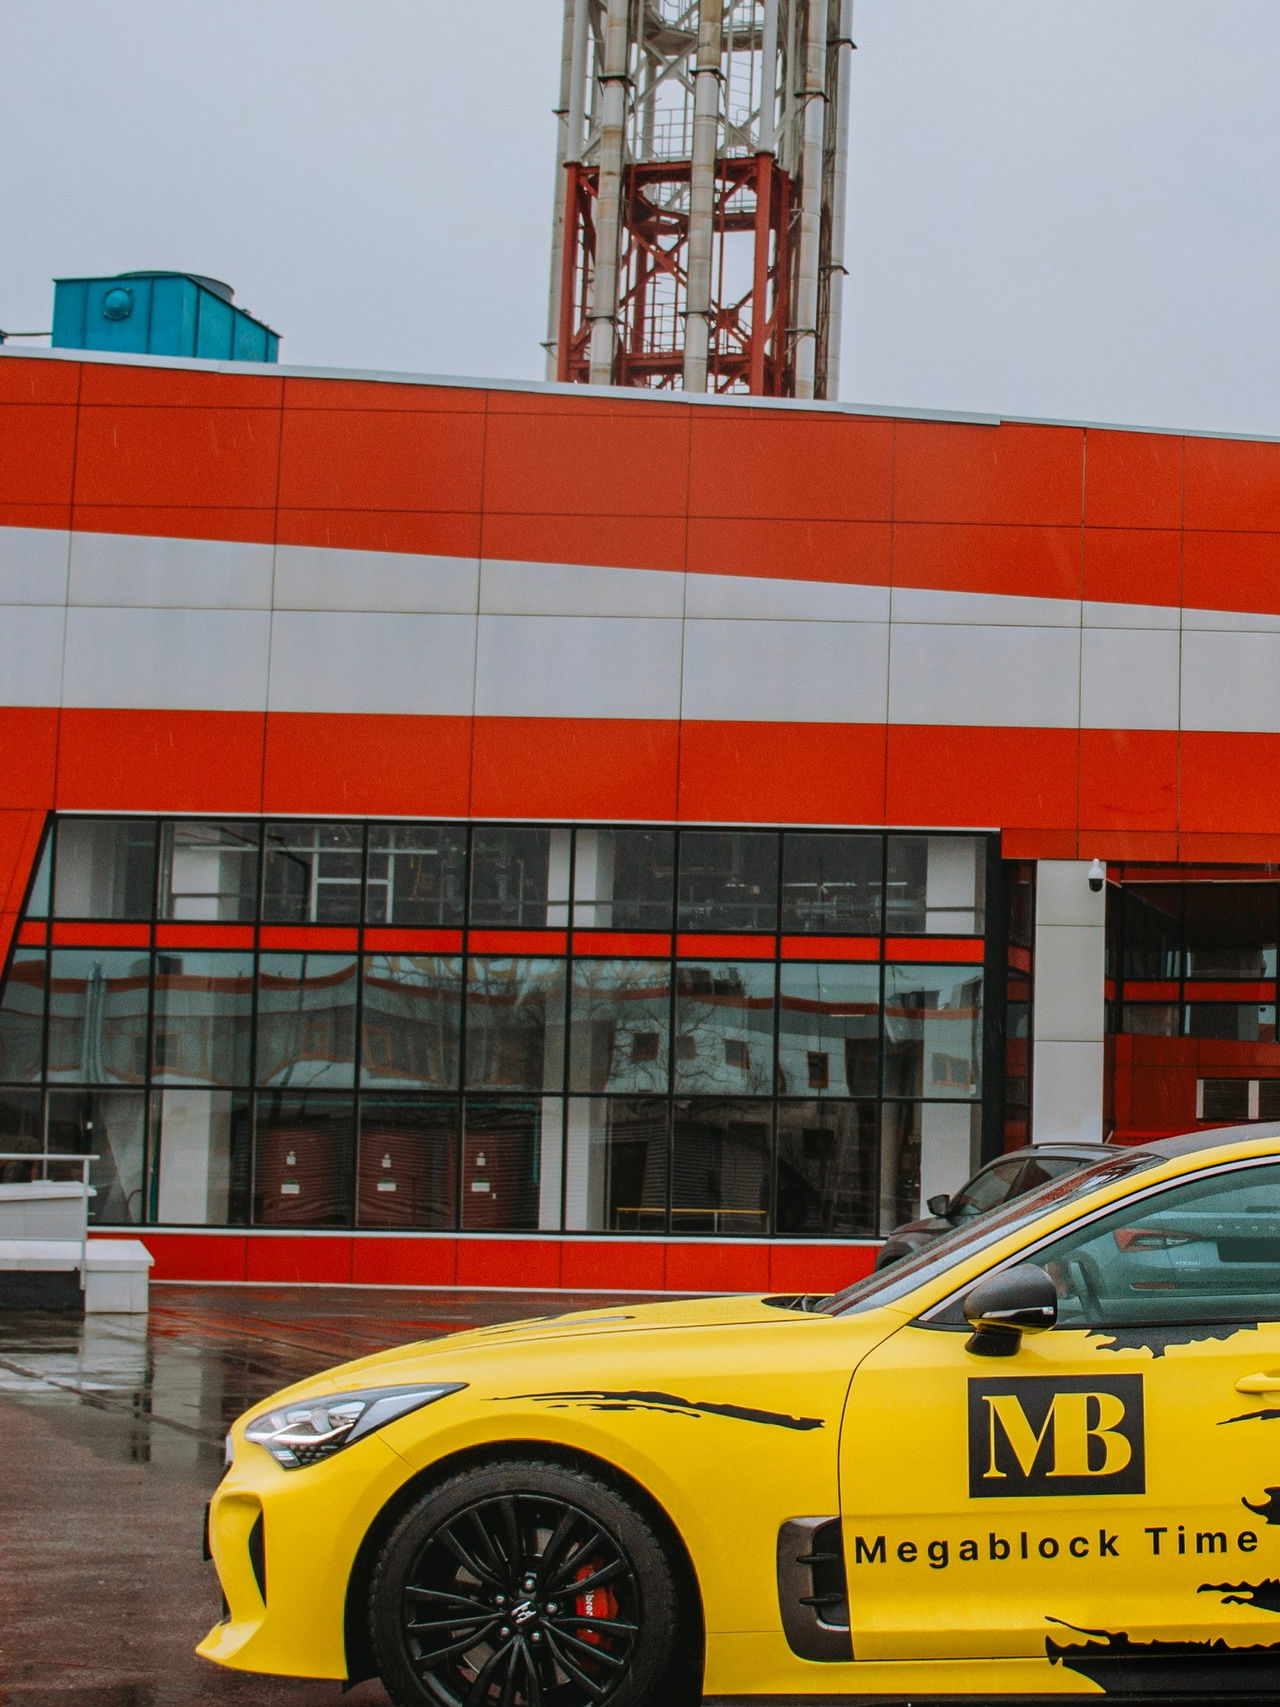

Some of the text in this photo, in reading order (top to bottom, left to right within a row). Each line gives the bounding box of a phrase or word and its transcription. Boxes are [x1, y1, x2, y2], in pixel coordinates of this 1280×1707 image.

[981, 1392, 1132, 1478] MB
[855, 1527, 1259, 1569] Megablock Time
